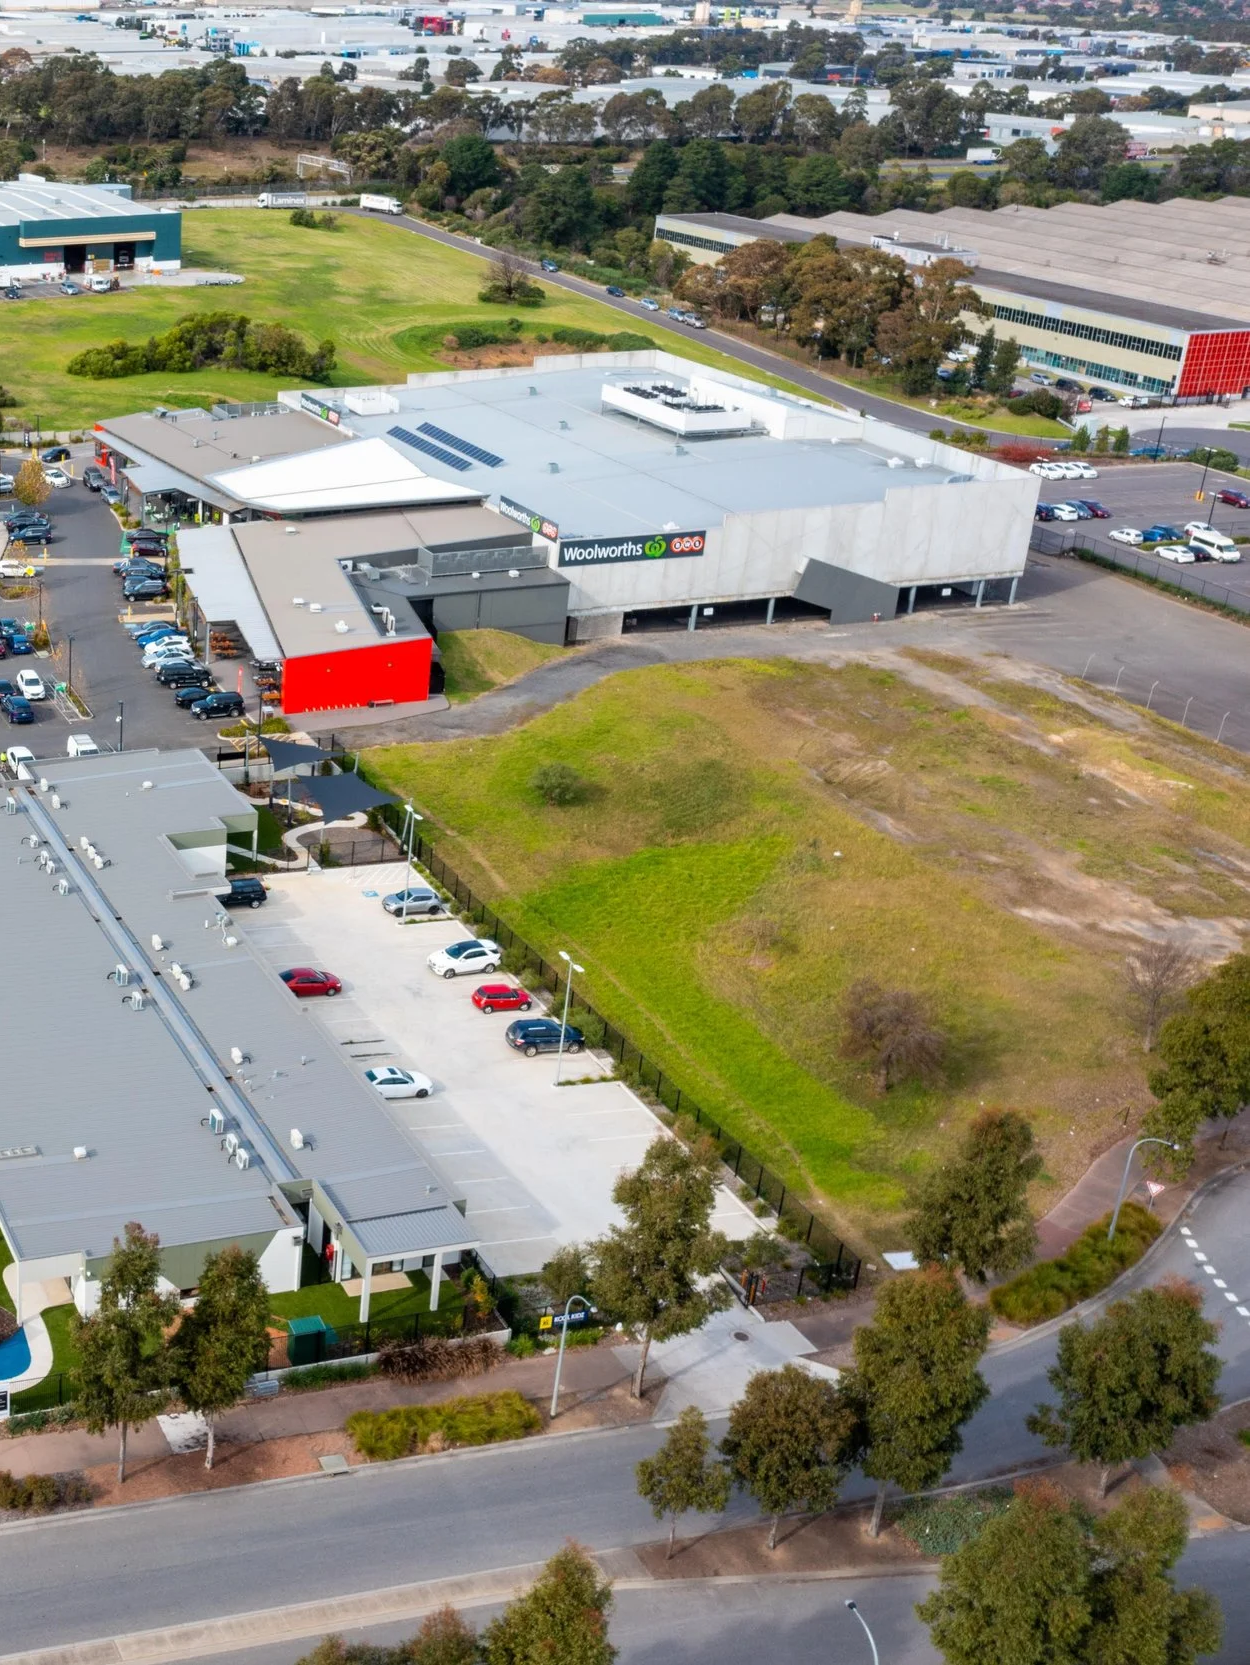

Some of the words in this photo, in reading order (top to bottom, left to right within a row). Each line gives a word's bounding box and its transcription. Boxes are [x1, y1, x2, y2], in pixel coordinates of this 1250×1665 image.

[273, 195, 305, 205] Laminex
[500, 500, 531, 527] Woolworths
[563, 541, 643, 562] Woolworths
